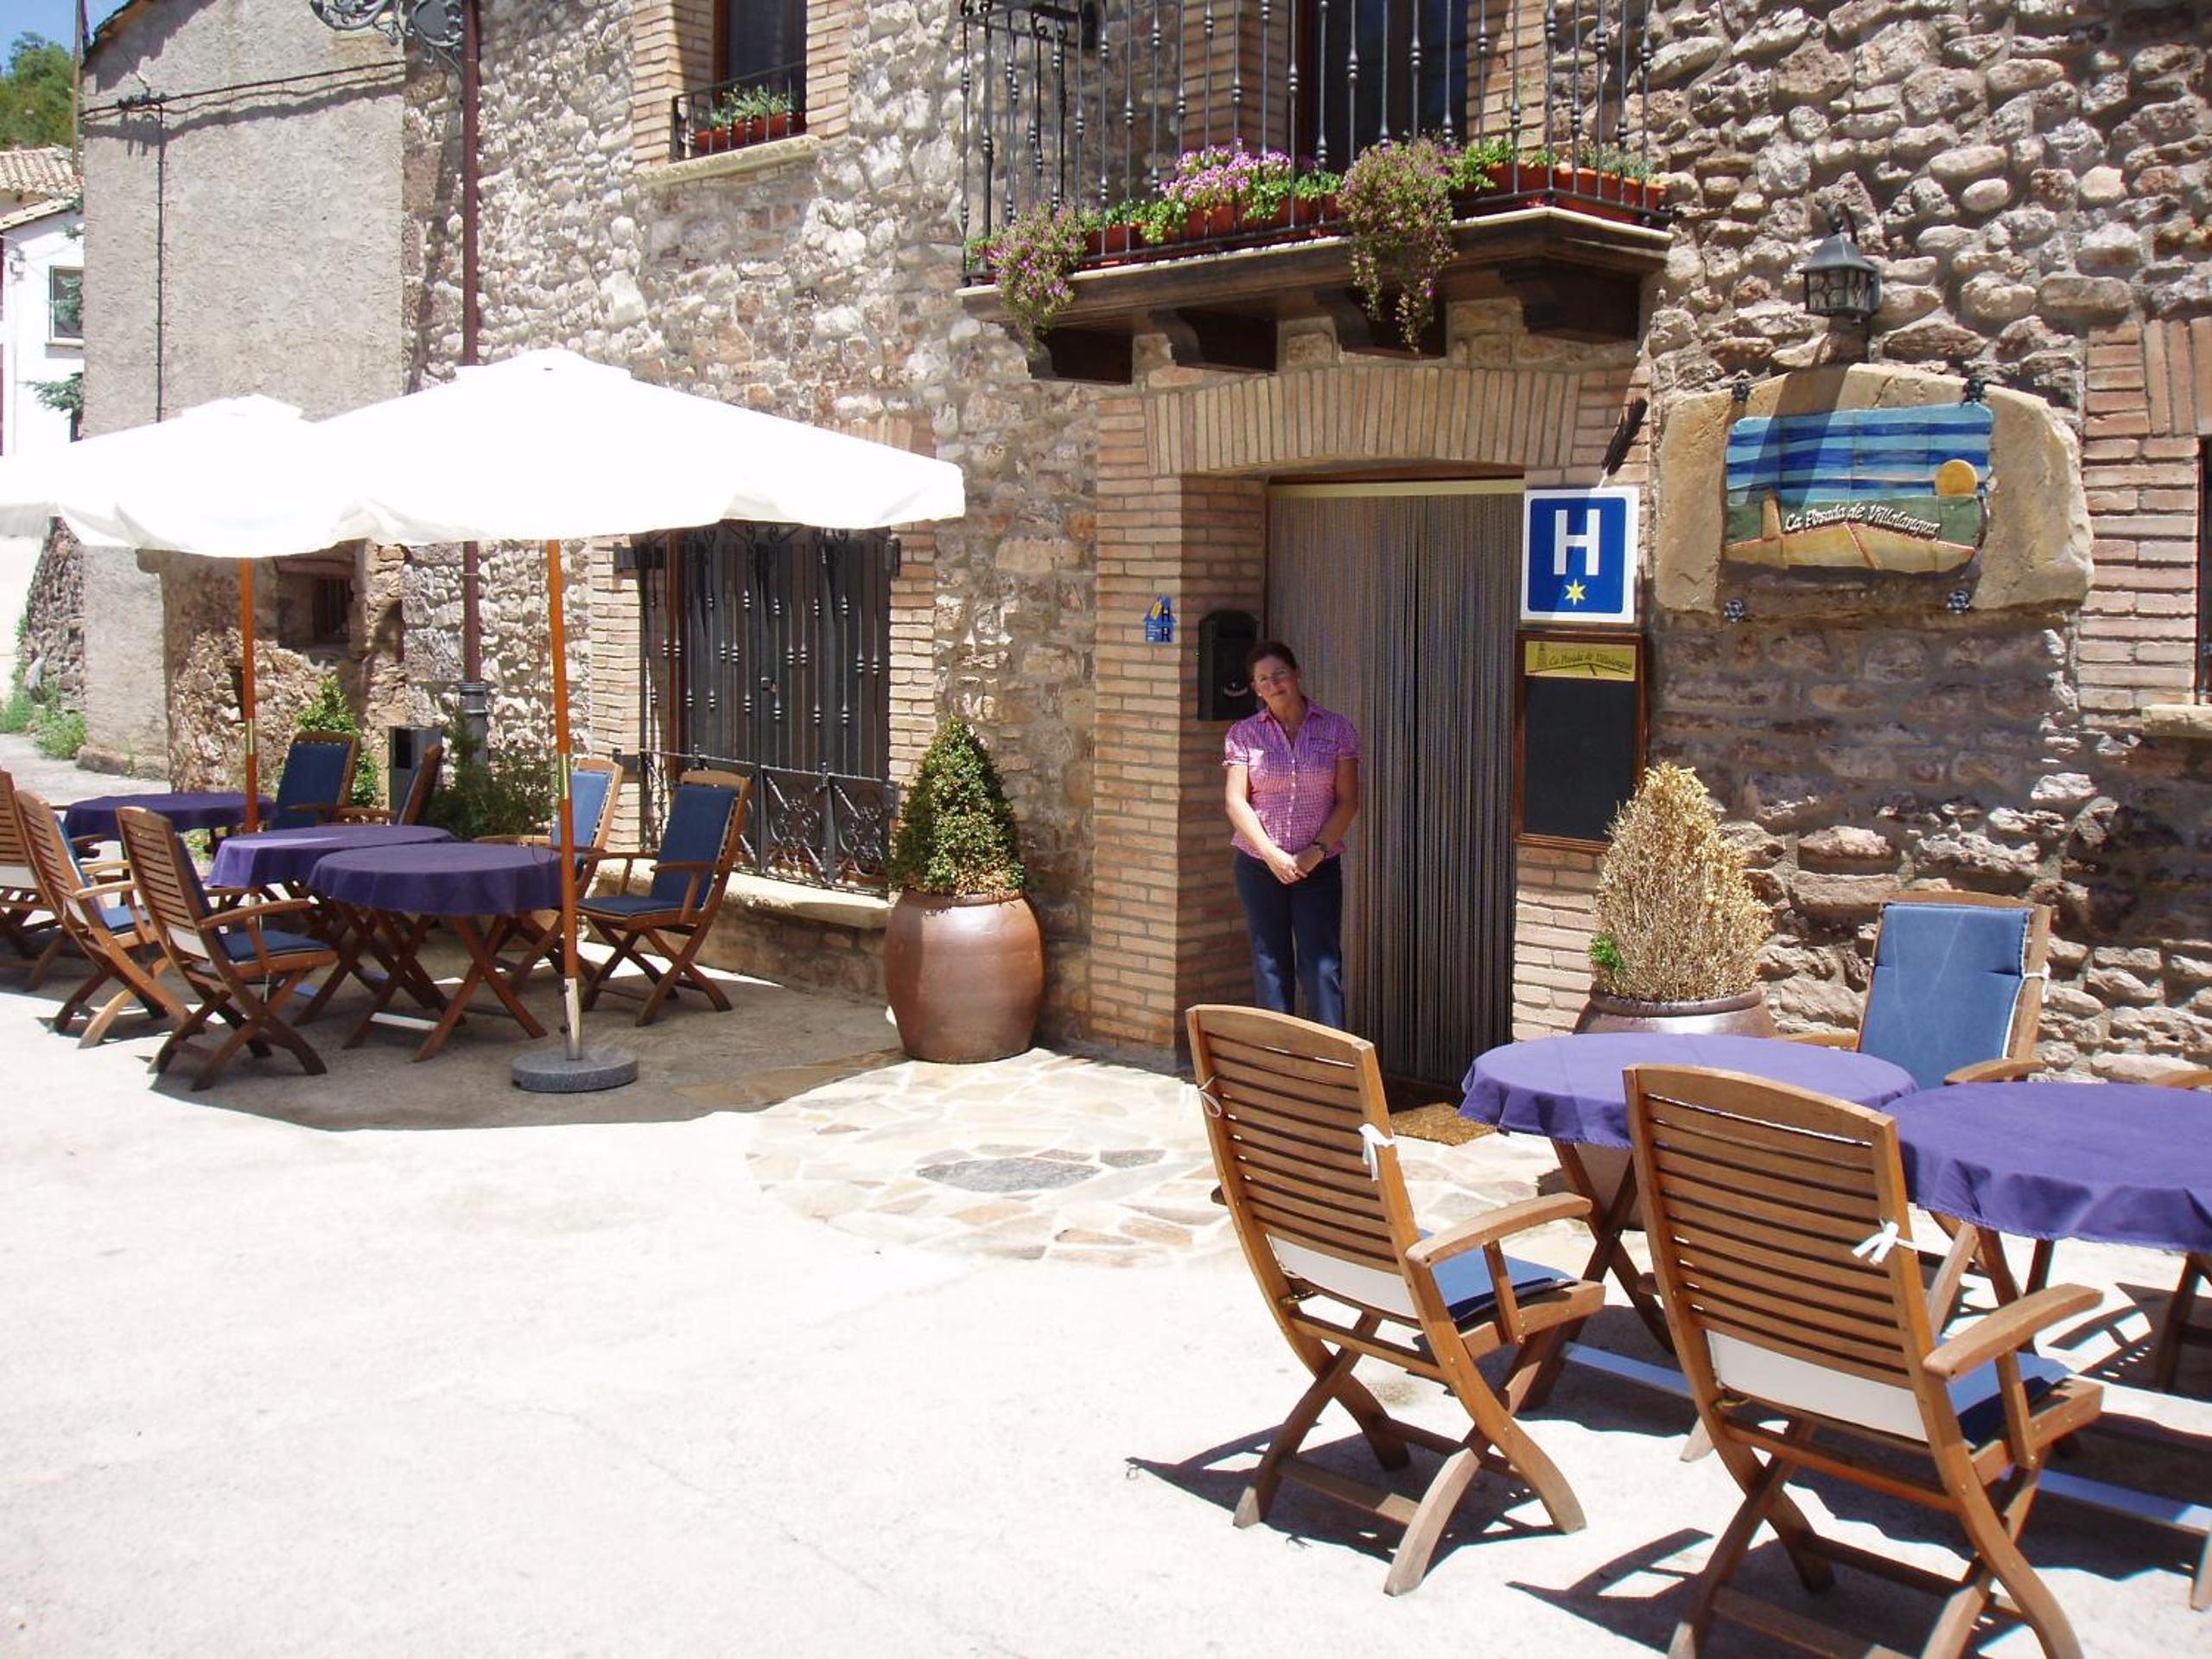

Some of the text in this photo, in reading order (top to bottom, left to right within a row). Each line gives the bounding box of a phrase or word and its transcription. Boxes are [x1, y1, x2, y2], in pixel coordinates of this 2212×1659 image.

[1805, 504, 1846, 528] Posada
[1847, 502, 1866, 518] de
[1554, 509, 1600, 575] H
